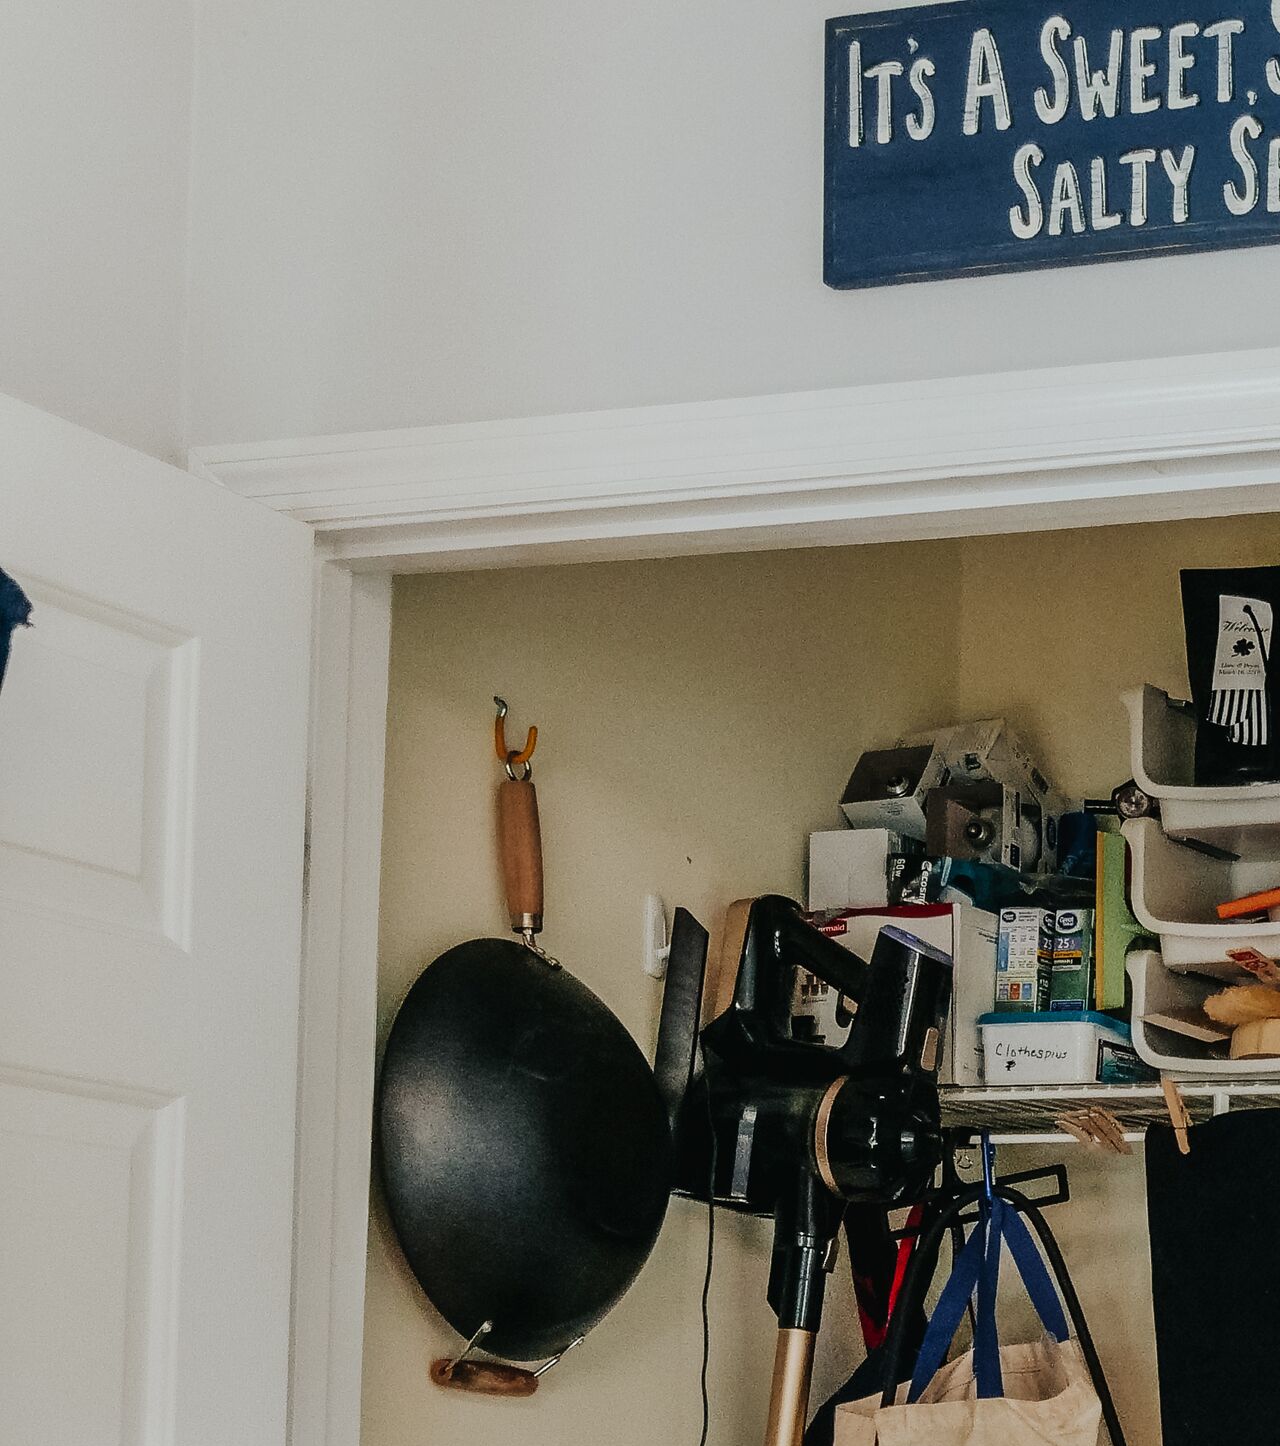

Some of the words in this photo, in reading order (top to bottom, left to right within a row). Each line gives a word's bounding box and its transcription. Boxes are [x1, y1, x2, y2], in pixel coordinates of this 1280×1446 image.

[963, 28, 1010, 136] A
[1009, 143, 1195, 240] SALTY
[1222, 620, 1271, 633] Welcoe
[1056, 938, 1071, 949] 25
